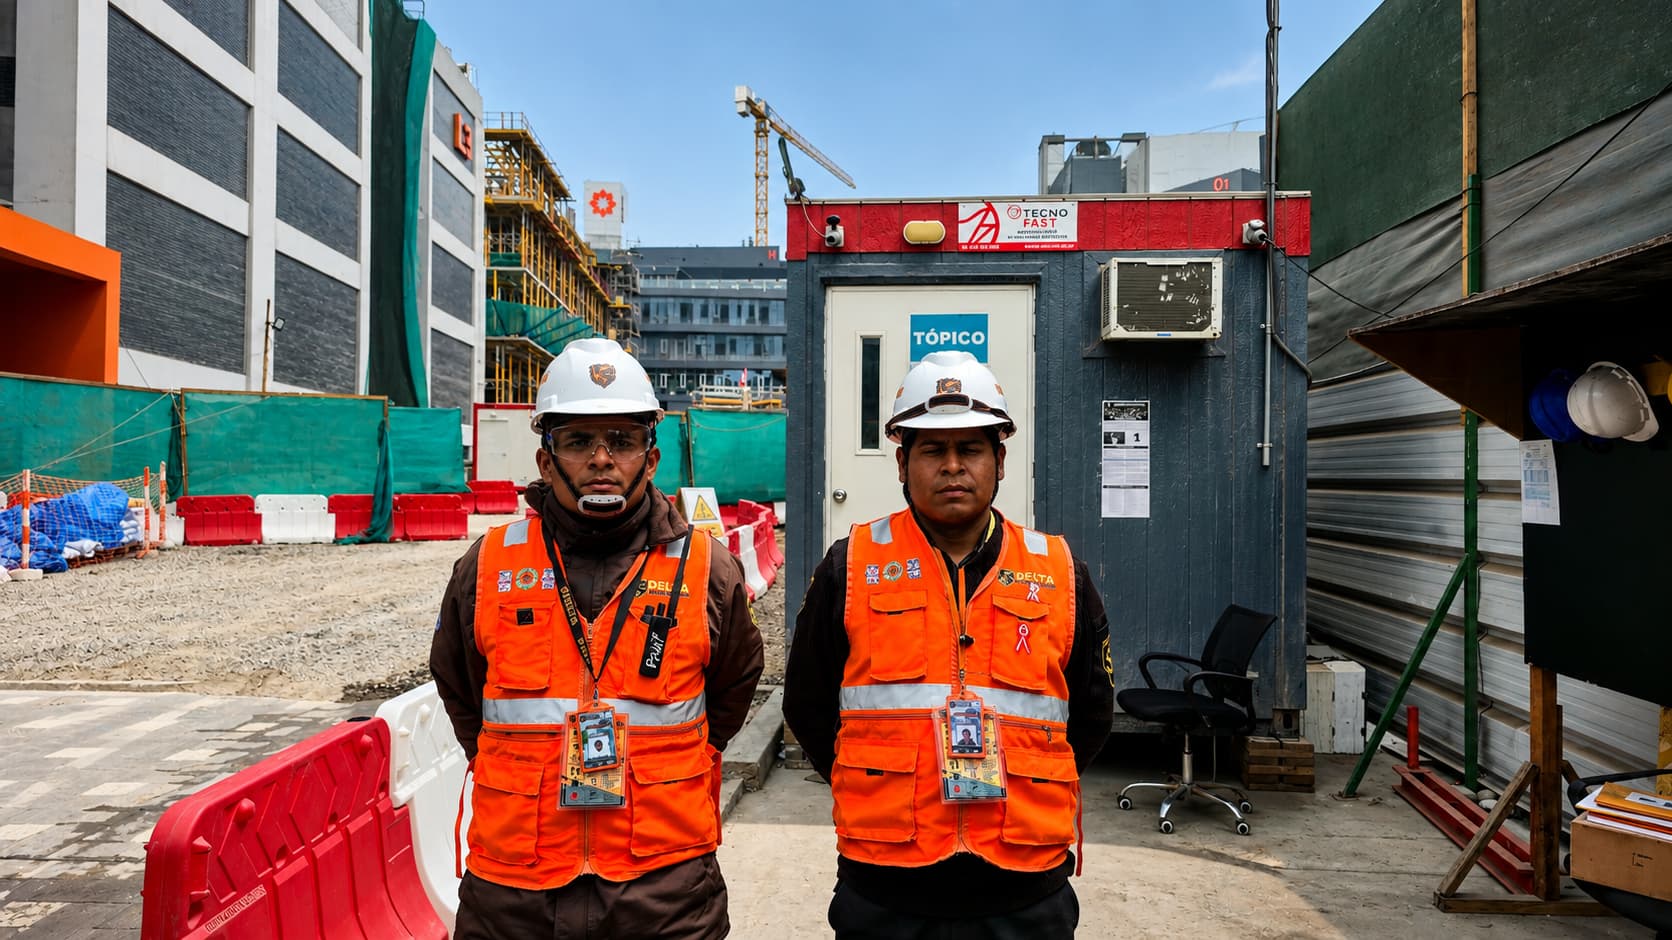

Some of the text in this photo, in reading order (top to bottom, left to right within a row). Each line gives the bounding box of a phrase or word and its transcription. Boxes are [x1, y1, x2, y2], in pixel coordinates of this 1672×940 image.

[1213, 177, 1229, 191] 01
[1023, 208, 1068, 218] TECNO
[1023, 218, 1057, 228] FAST
[767, 249, 777, 260] H
[913, 328, 985, 345] TÓPICO
[1133, 433, 1141, 442] 1
[1016, 571, 1054, 585] DELTA
[647, 580, 689, 593] DELA
